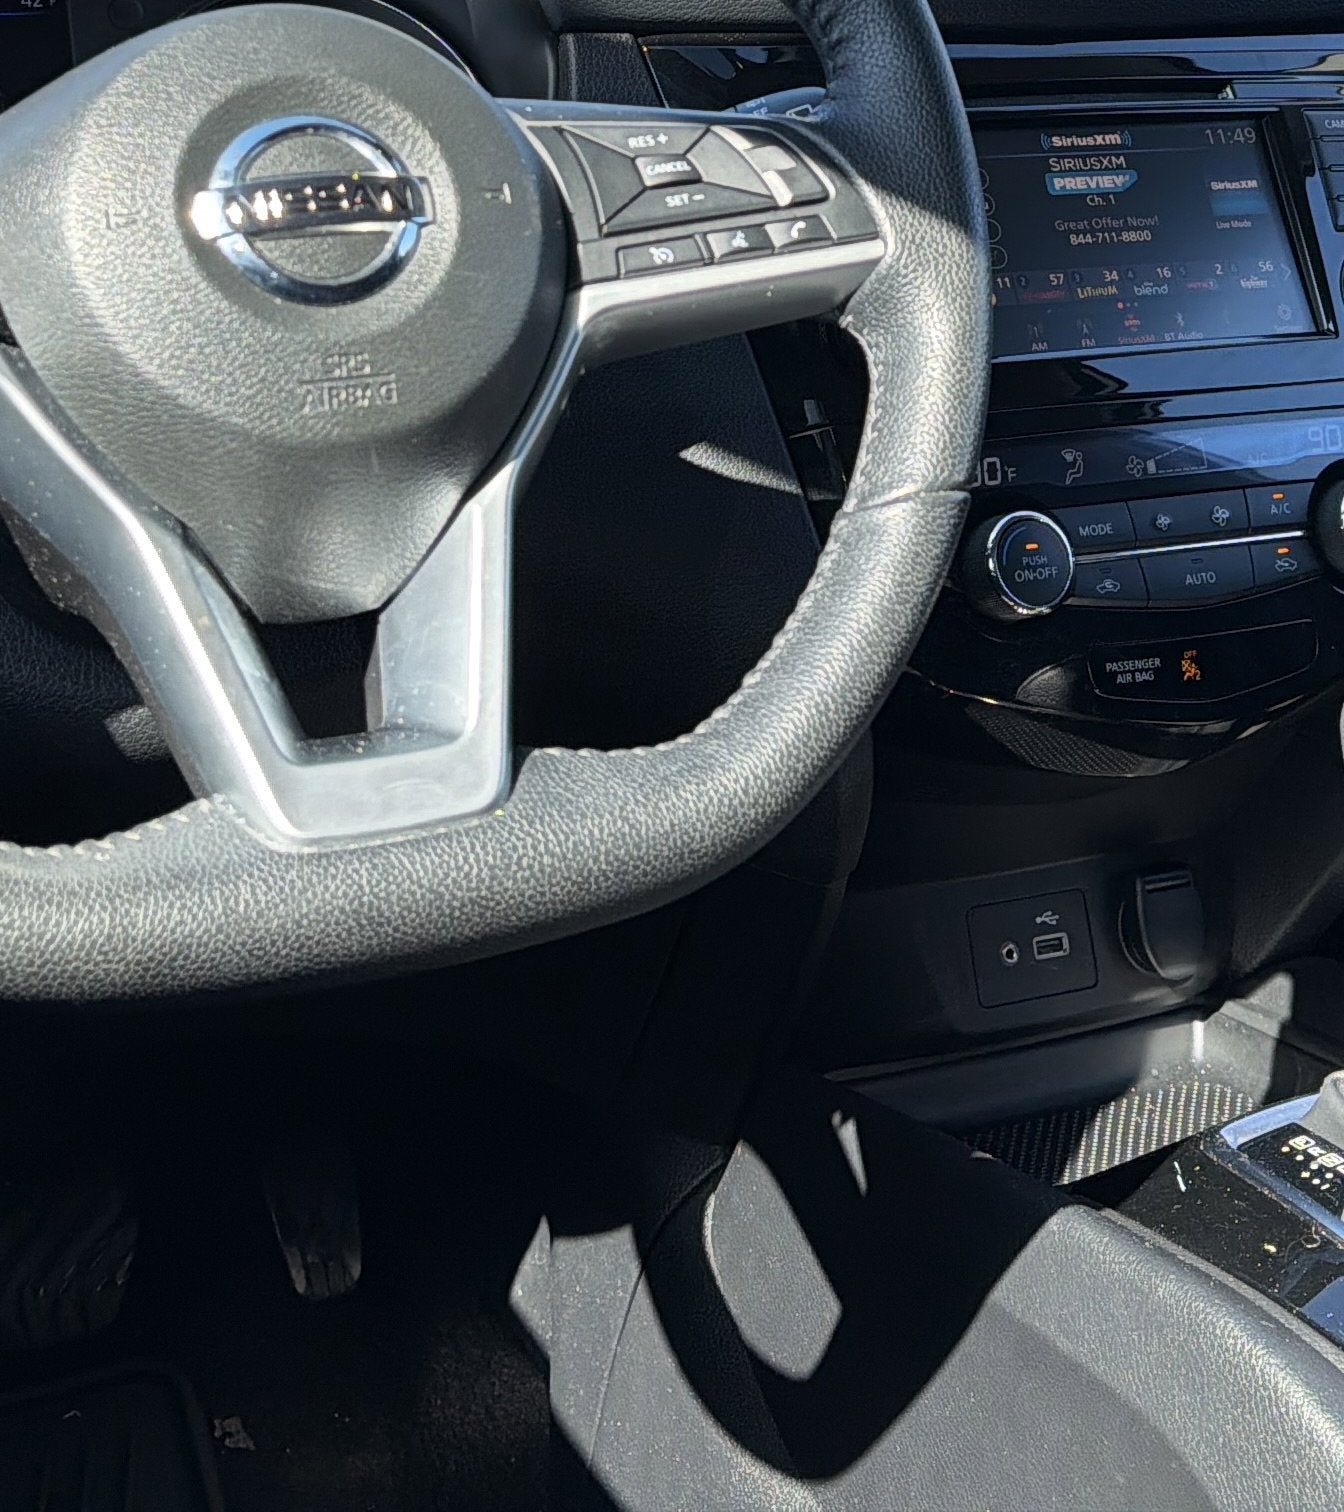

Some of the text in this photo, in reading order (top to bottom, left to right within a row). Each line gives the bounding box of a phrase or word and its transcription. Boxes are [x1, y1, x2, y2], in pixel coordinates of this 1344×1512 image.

[1205, 127, 1256, 145] 11:49
[646, 160, 693, 176] CANCEL
[1049, 155, 1127, 172] SIRIUSXM
[1086, 194, 1116, 206] Ch. 1
[1054, 214, 1160, 231] Great Offer Now!
[1069, 229, 1152, 246] 844-711-8800
[1048, 273, 1064, 286] 57
[1103, 270, 1120, 283] 34
[1156, 266, 1172, 279] 16
[1214, 263, 1224, 276] 2
[1258, 260, 1274, 273] 56
[1031, 341, 1049, 353] AM
[1081, 337, 1097, 349] FM
[1270, 502, 1292, 515] A/C
[1079, 522, 1114, 537] MODE
[1022, 554, 1048, 567] PUSH
[1185, 571, 1216, 586] AUTO
[1105, 657, 1161, 673] PASSENGER
[1116, 671, 1155, 684] AIR BAG
